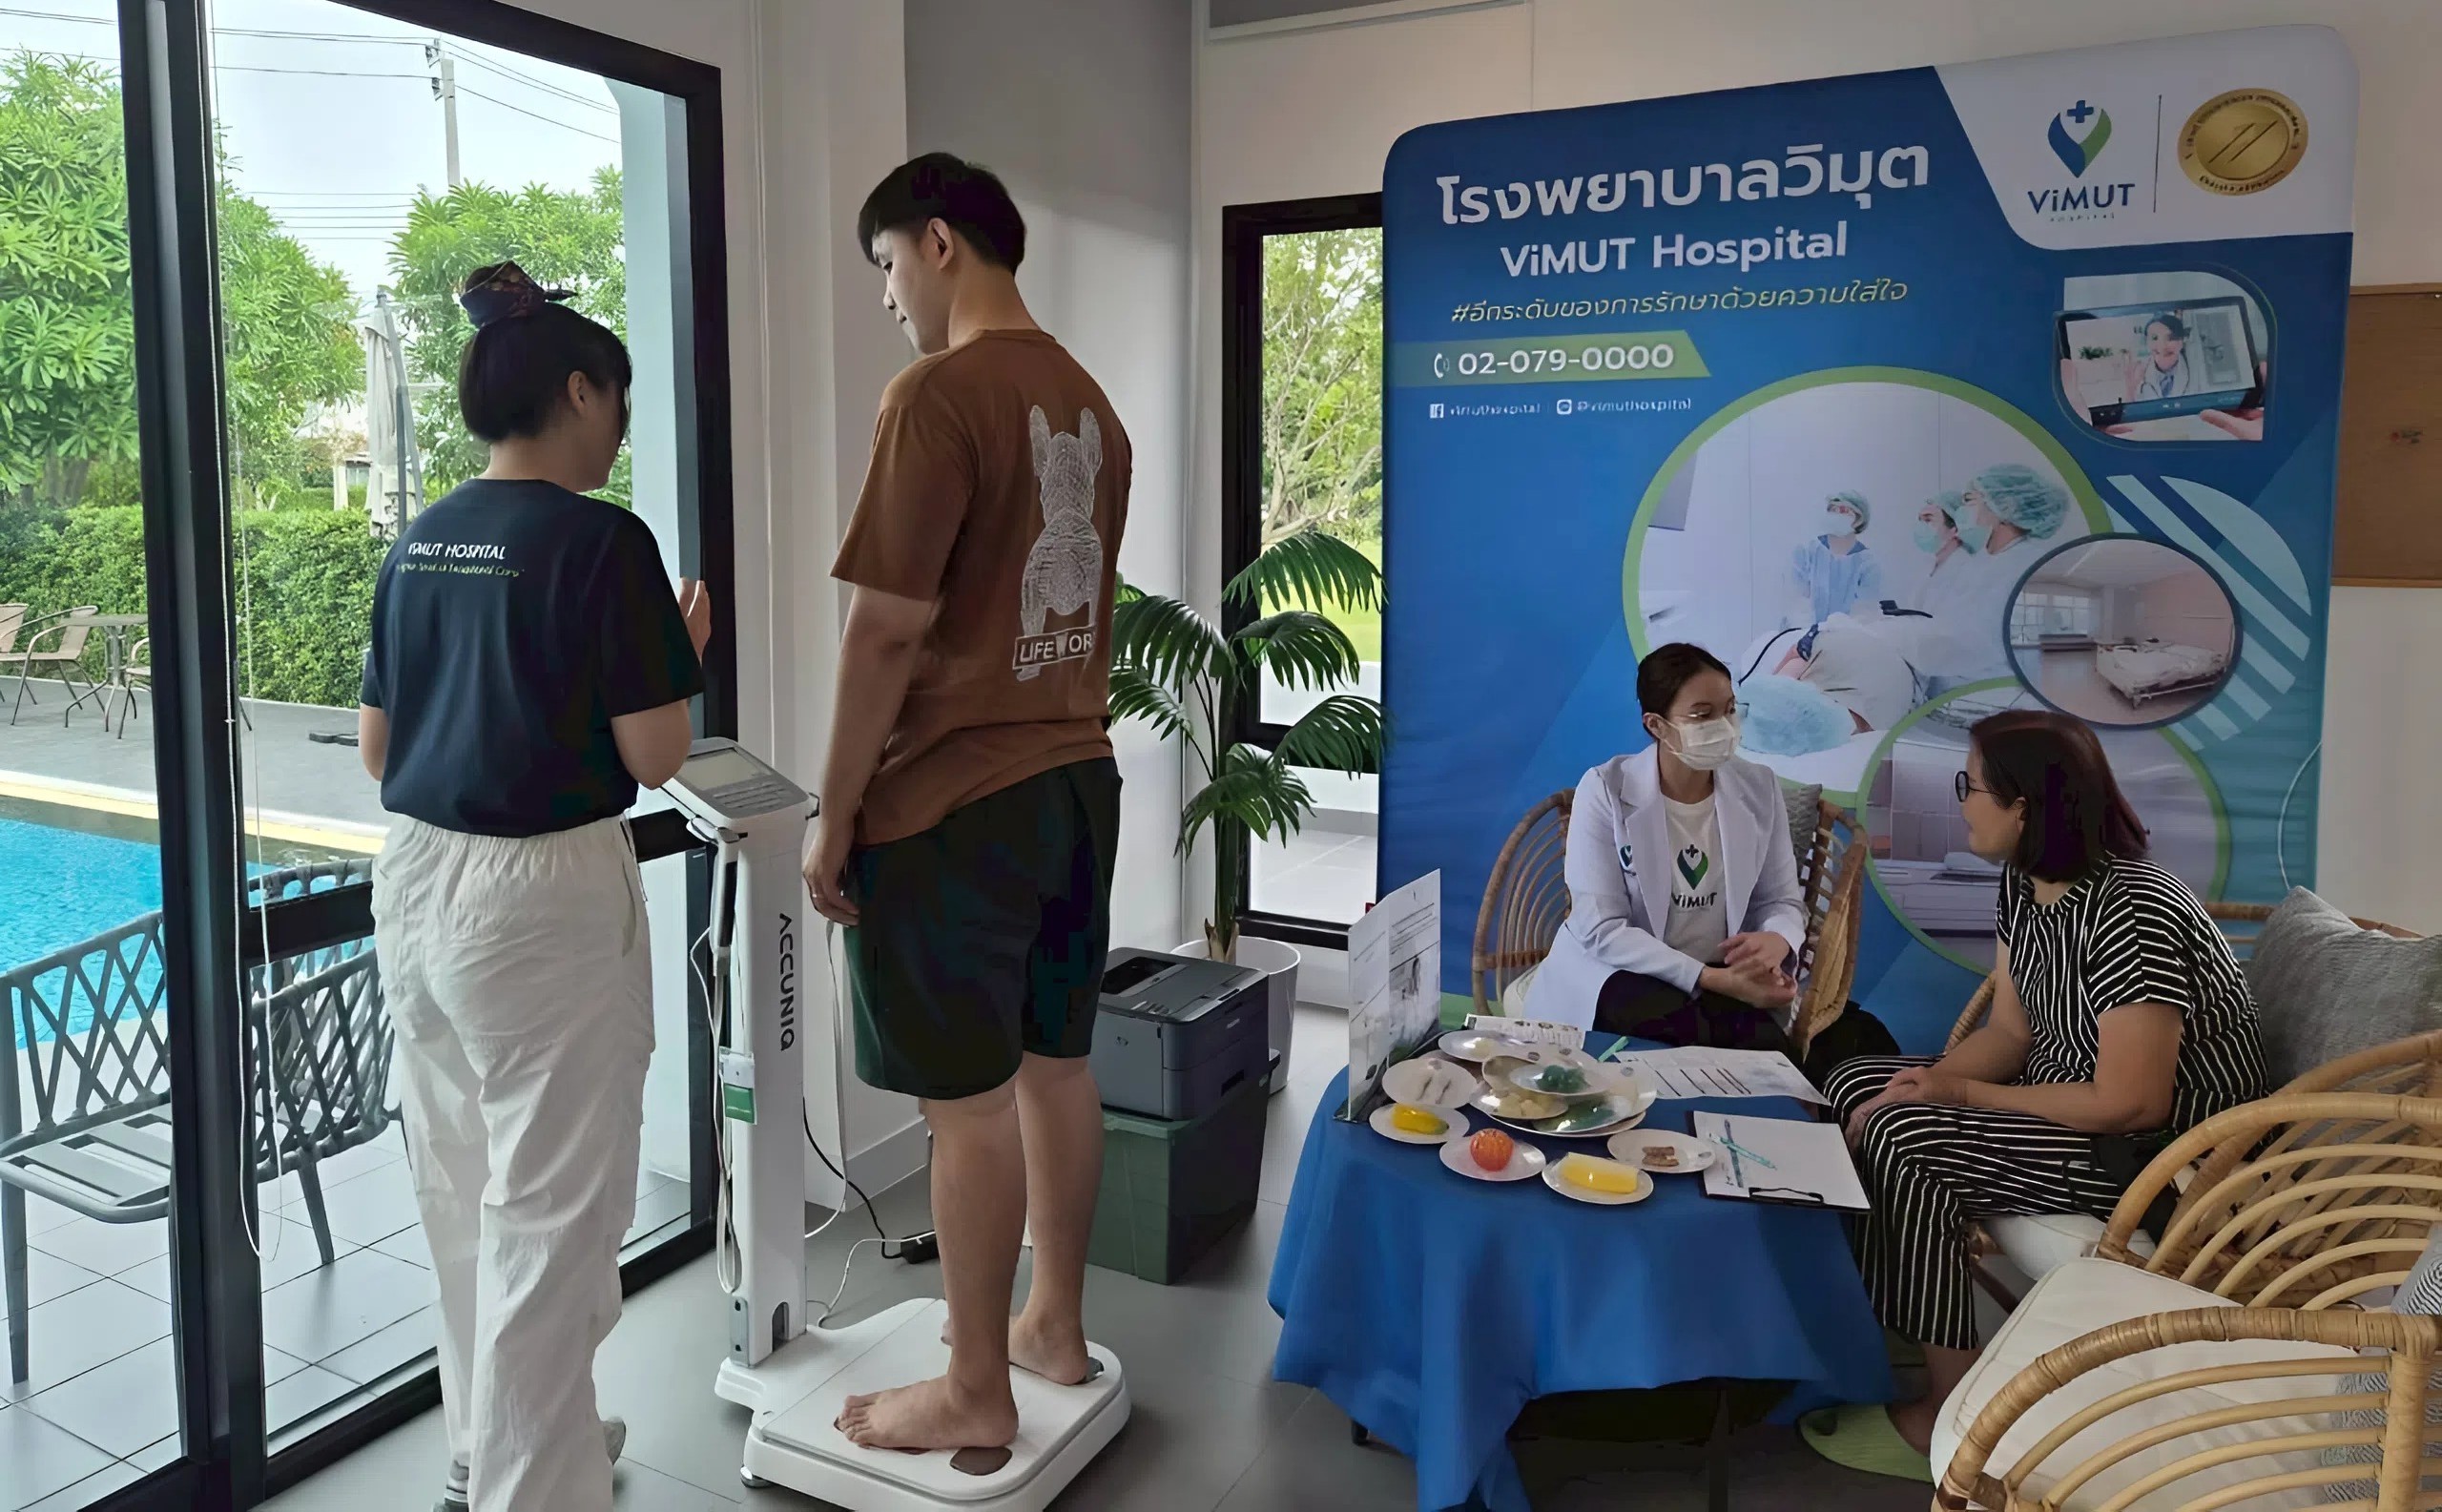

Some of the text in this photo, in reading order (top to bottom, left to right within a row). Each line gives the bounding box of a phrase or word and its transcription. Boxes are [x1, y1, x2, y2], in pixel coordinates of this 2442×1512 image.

[1436, 143, 1929, 225] โรงพยาบาลวิมุต
[2027, 183, 2136, 215] ViMUT
[1500, 219, 1848, 277] ViMUT Hospital
[1458, 342, 1675, 376] 02-079-0000
[445, 544, 507, 560] HOSPITAL
[778, 912, 796, 1052] ACCUNIQ
